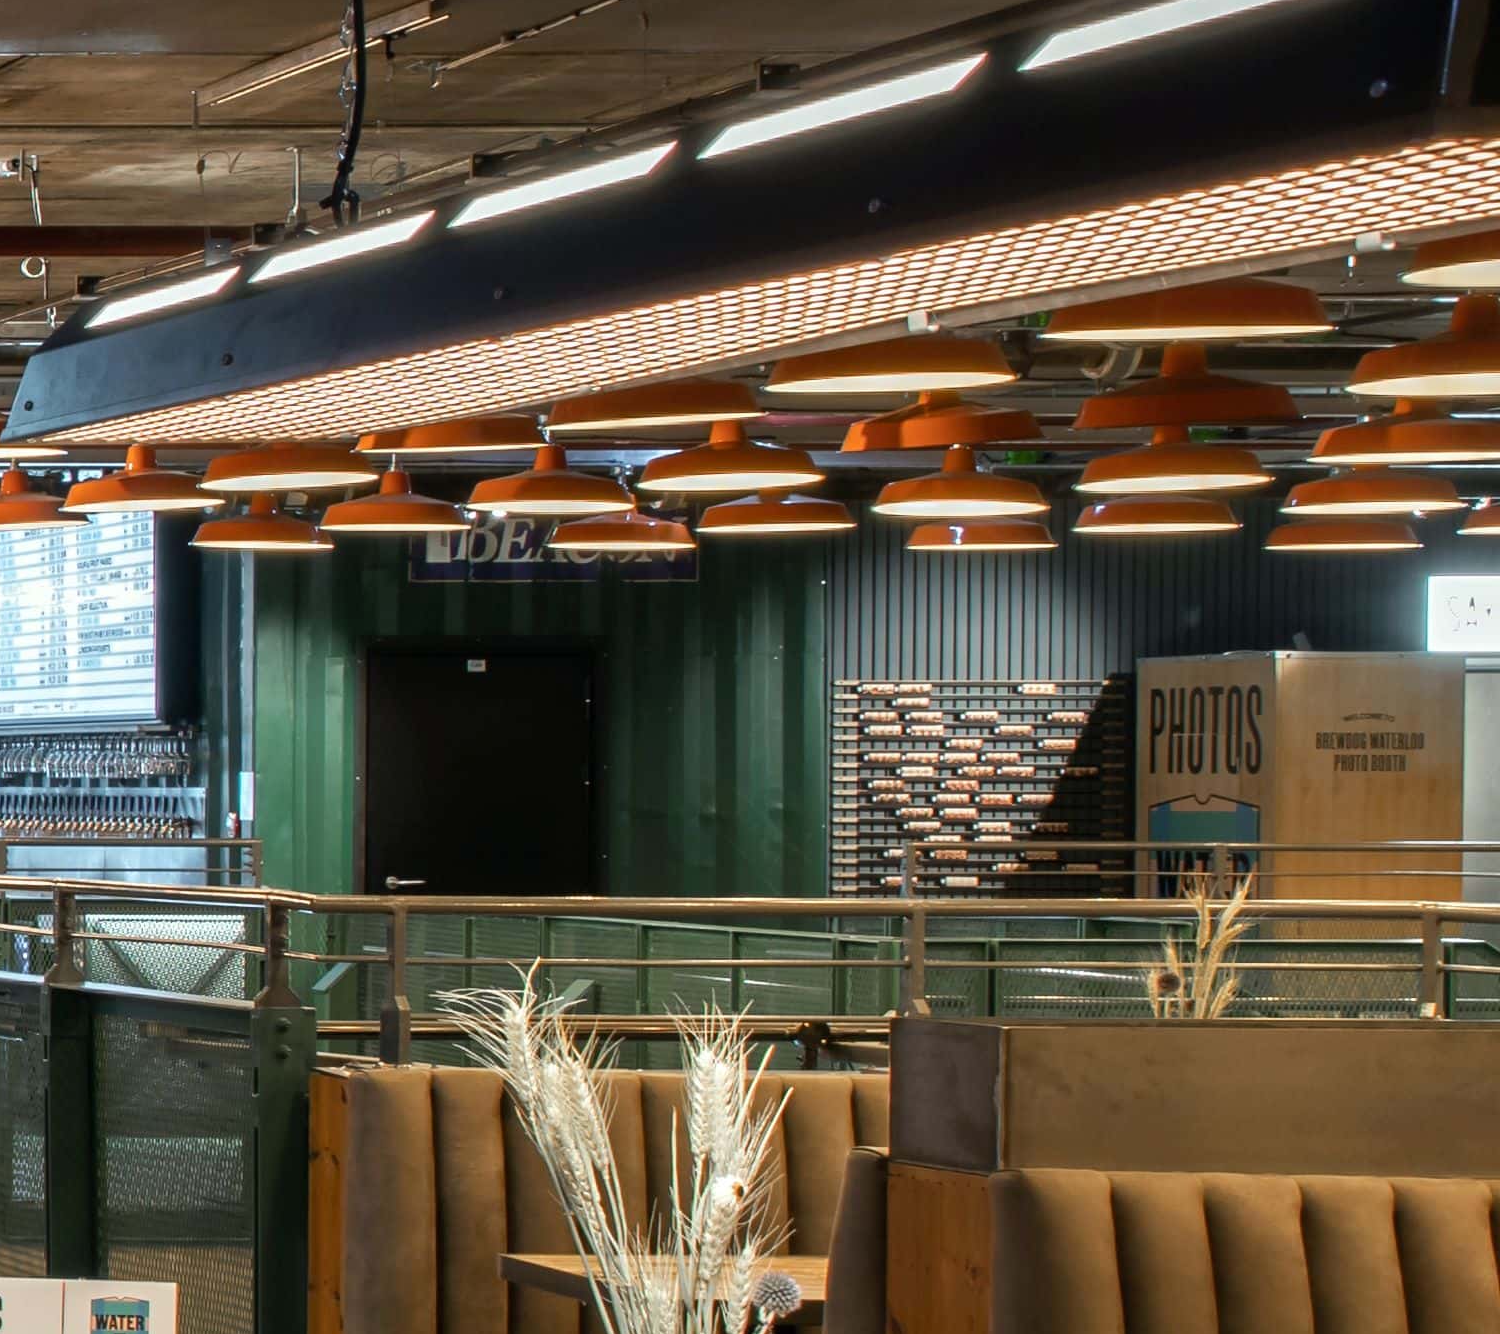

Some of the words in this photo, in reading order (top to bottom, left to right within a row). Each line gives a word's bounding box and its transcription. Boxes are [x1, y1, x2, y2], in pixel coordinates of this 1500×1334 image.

[1149, 684, 1262, 775] PHOTOS
[1155, 848, 1250, 900] WATR
[95, 1315, 145, 1331] WATER
